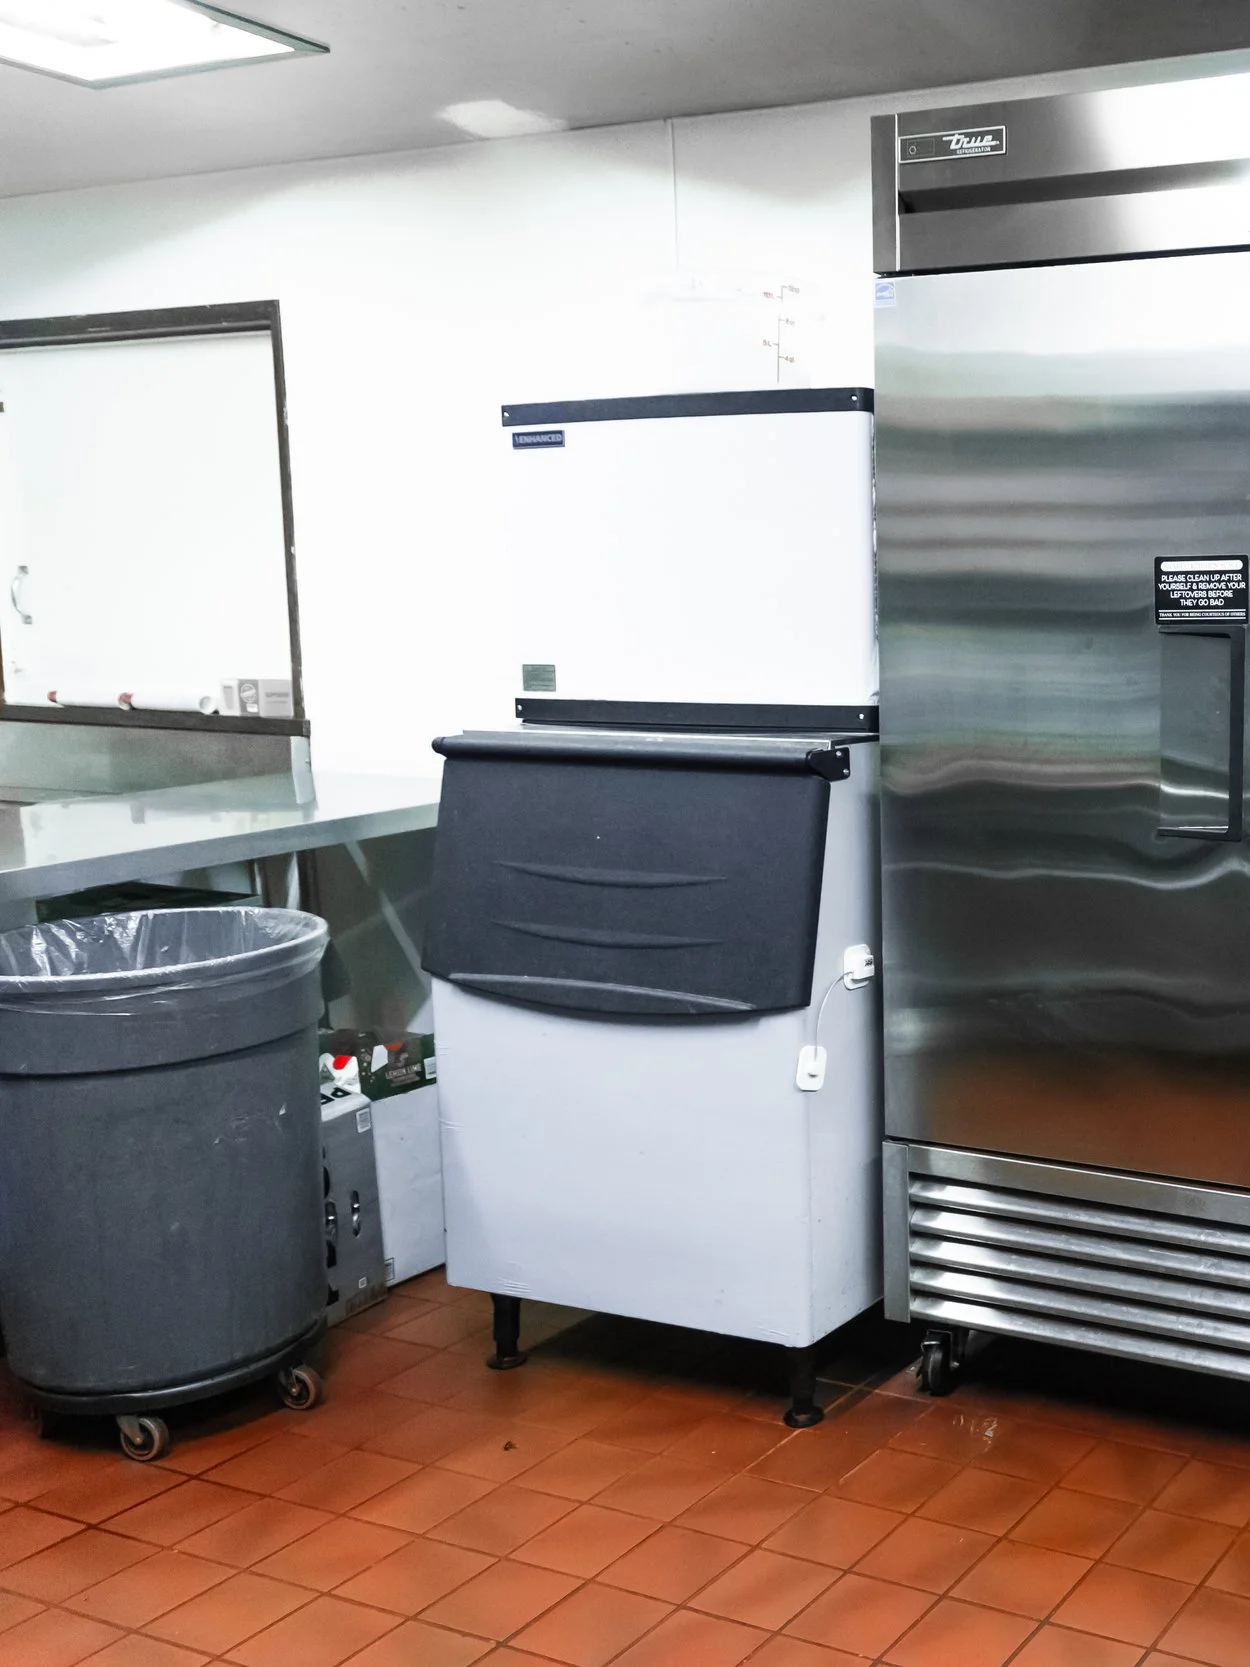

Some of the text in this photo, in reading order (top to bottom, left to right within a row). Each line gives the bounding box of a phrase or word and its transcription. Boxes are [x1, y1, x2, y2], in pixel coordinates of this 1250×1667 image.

[956, 146, 991, 155] REFRIGERATOR
[1161, 574, 1186, 582] PLEASE
[1187, 574, 1209, 582] CLEAN
[1221, 573, 1242, 581] AFTER
[1158, 581, 1246, 590] YOURSELF & REMOVE YOUR
[1208, 590, 1233, 598] BEFORE
[1210, 598, 1224, 606] BAD
[385, 1063, 421, 1079] LEMON LIME
